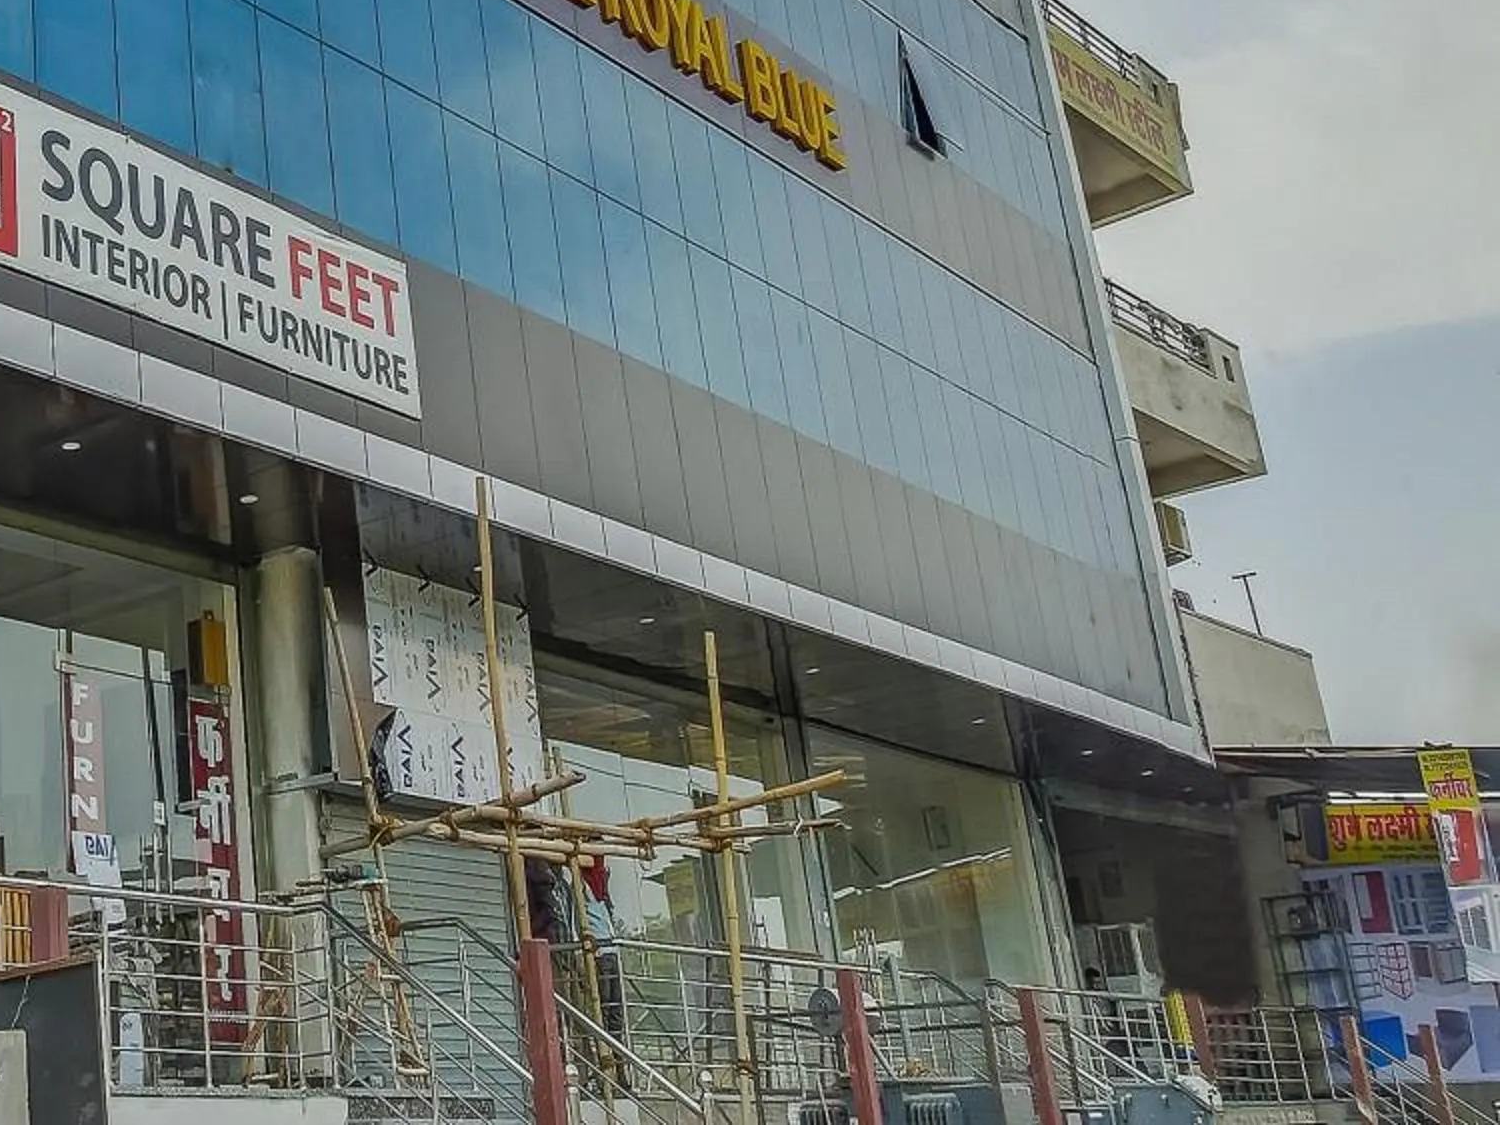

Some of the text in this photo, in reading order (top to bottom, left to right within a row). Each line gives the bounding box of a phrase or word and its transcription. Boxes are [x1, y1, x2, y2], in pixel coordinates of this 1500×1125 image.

[735, 39, 847, 171] BLUE
[41, 130, 400, 337] SQUARE FEET
[42, 215, 211, 319] INTERIOR
[238, 291, 409, 395] FURNITURE
